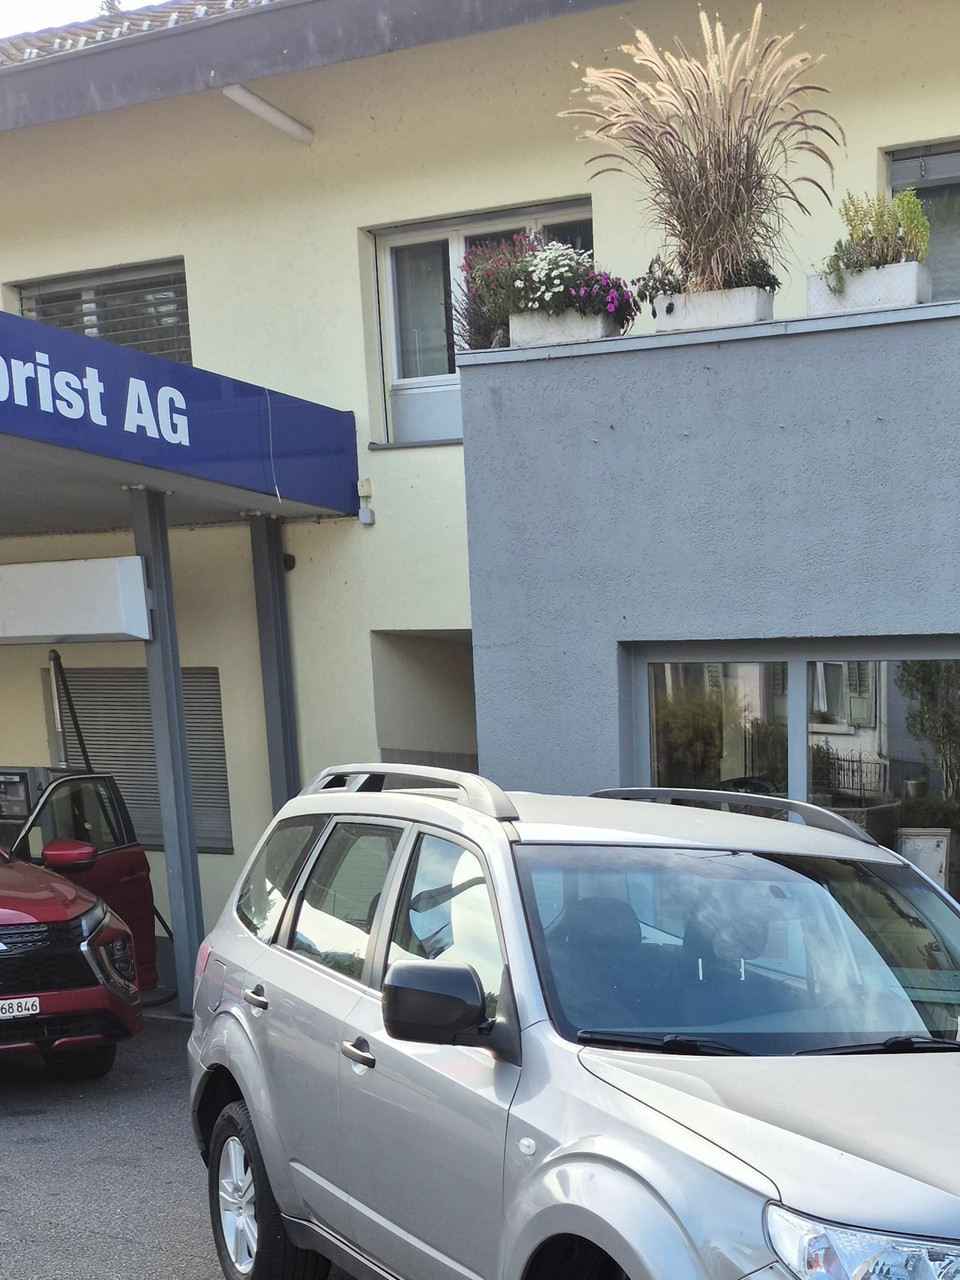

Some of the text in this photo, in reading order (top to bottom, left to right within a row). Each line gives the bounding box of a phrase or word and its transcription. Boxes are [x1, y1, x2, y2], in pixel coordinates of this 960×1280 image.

[124, 377, 190, 446] AG
[0, 1000, 38, 1015] 68 846
